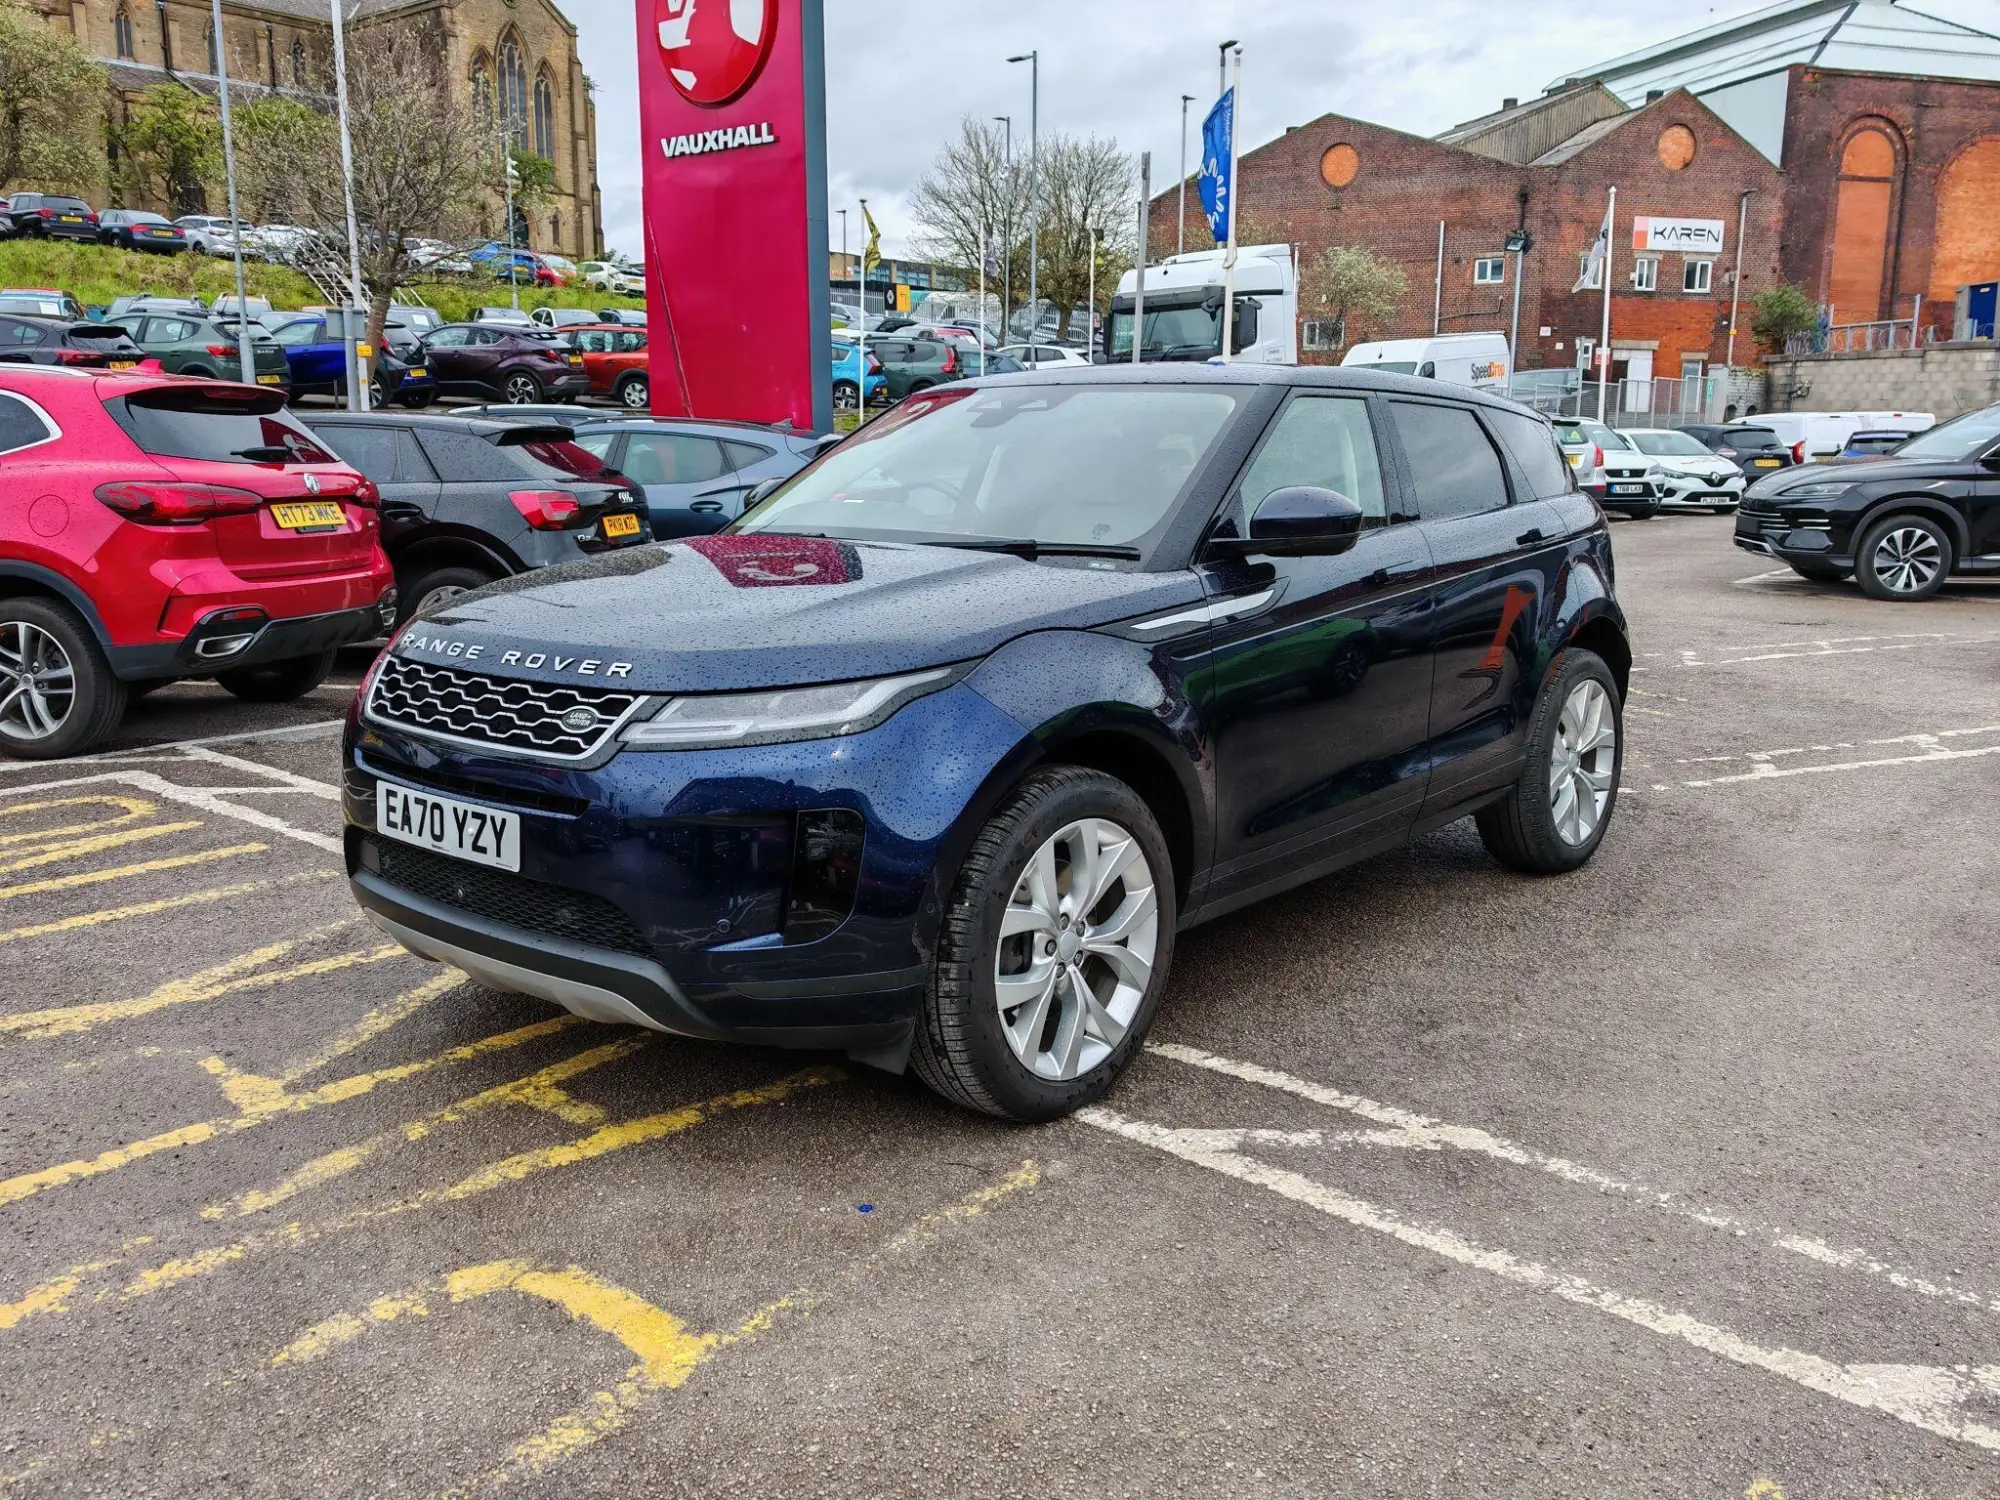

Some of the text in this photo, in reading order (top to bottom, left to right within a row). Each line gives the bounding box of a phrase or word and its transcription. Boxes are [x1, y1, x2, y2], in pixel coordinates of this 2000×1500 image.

[660, 122, 775, 157] VAUXHALL
[1653, 226, 1720, 243] KAREN
[277, 504, 341, 524] HT73 MKE
[400, 633, 633, 678] RANGE ROVER
[385, 788, 507, 858] EA70 YZY
